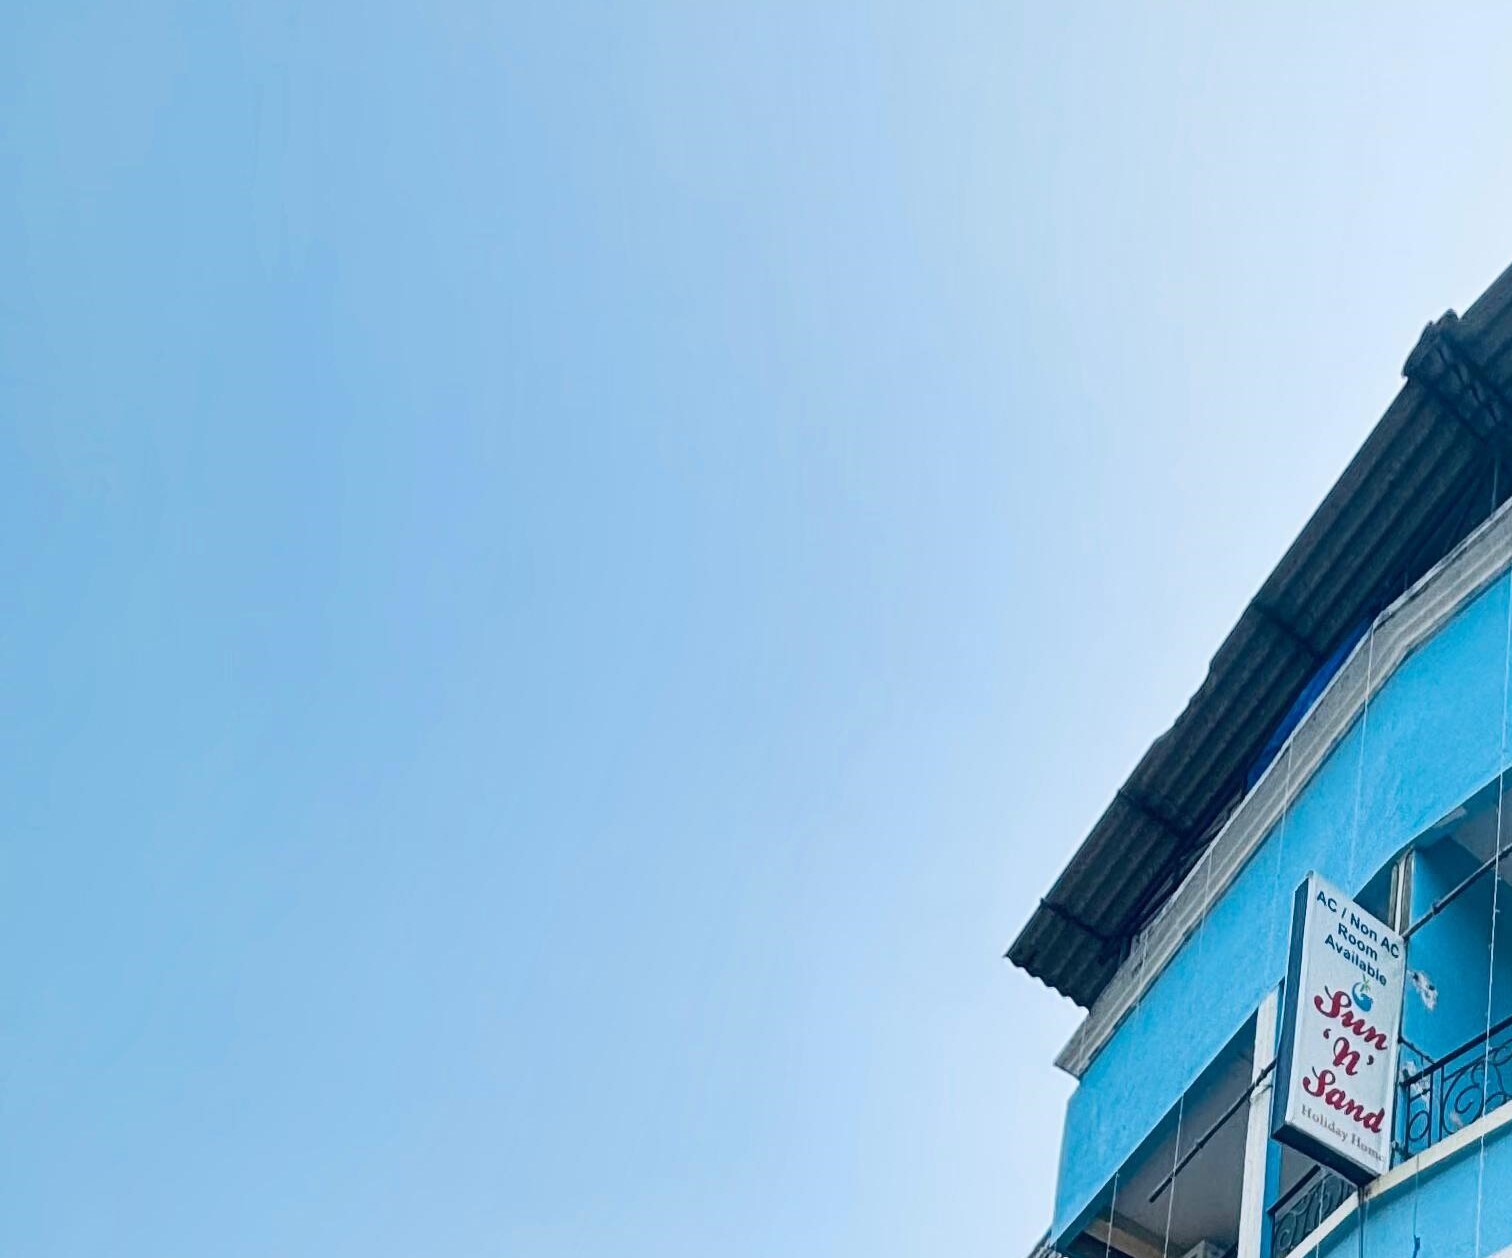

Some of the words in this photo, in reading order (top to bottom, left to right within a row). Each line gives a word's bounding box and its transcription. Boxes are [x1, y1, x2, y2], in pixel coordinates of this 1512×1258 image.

[1316, 890, 1337, 913] AC
[1350, 912, 1378, 942] Non
[1380, 935, 1400, 959] AC
[1337, 922, 1378, 962] Room
[1324, 934, 1387, 987] Available
[1313, 985, 1388, 1051] Sun
[1302, 1066, 1386, 1134] Sand
[1301, 1104, 1349, 1142] Holiday
[1351, 1132, 1385, 1162] Home
